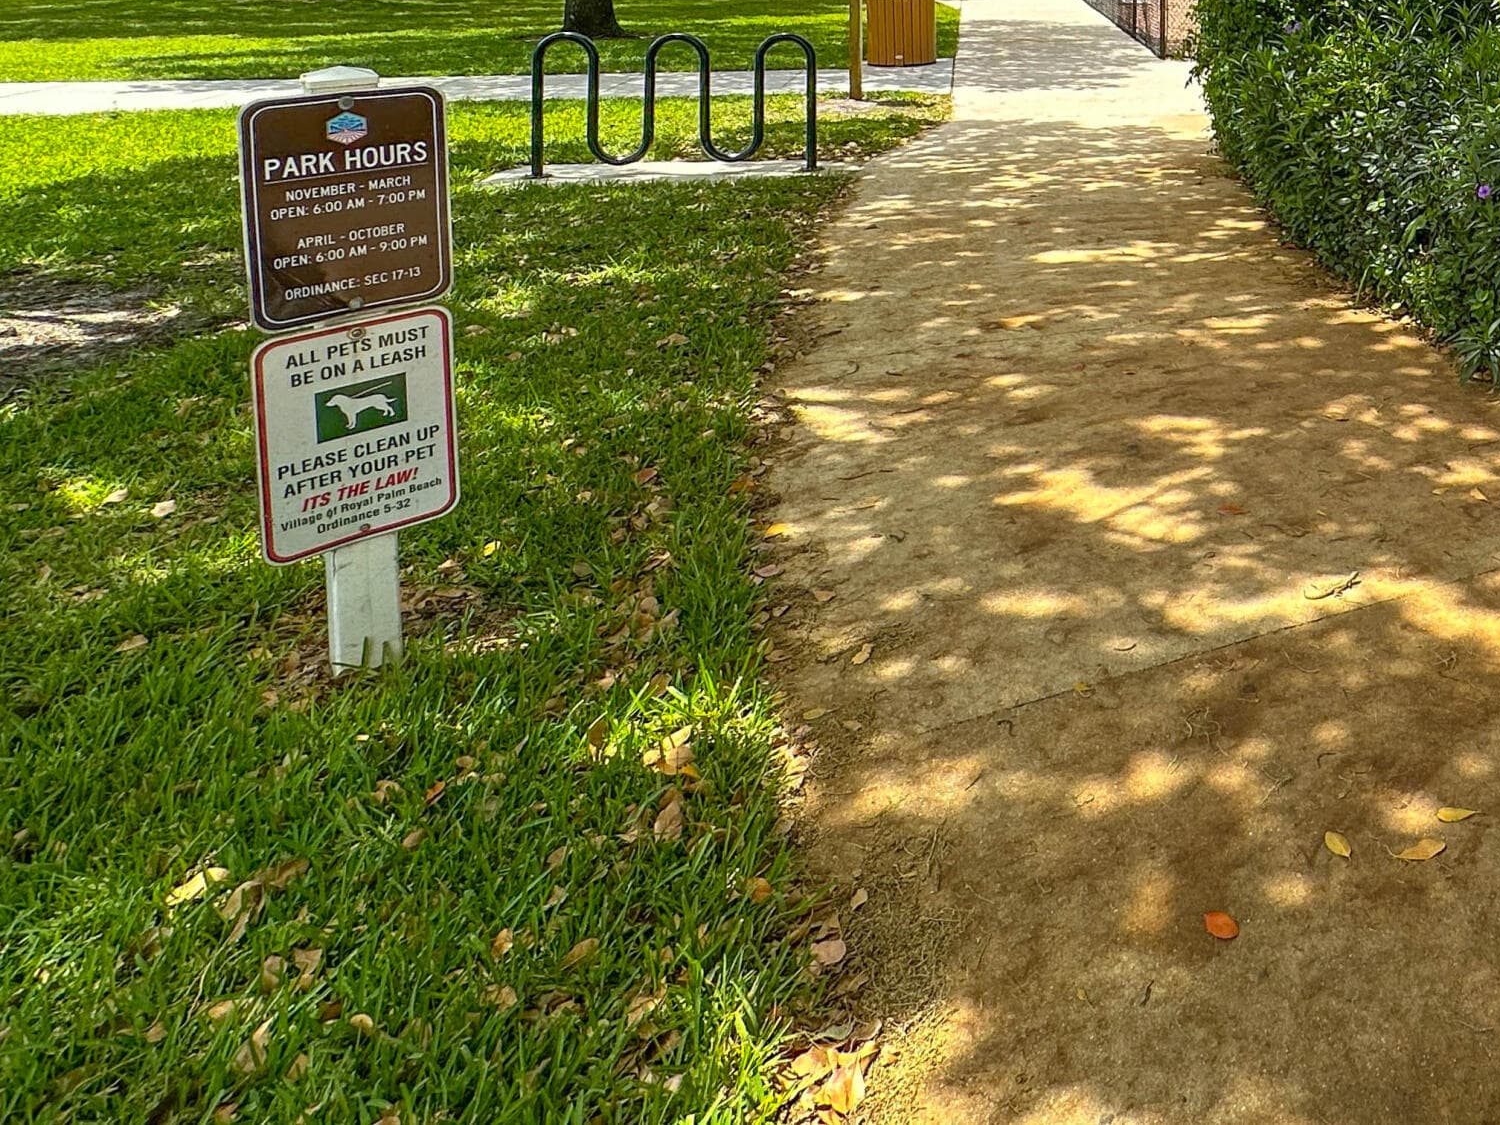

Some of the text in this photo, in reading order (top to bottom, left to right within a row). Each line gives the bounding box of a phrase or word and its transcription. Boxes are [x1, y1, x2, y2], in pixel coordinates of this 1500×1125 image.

[264, 141, 428, 181] PARK HOURS
[270, 206, 309, 220] OPEN:
[313, 200, 343, 215] 6:00
[347, 197, 365, 209] AM
[377, 192, 406, 206] 7:00
[409, 189, 426, 200] PM
[286, 182, 356, 202] NOVEMBER
[368, 175, 411, 190] MARCH
[273, 254, 312, 270] OPEN:
[315, 249, 345, 263] 6:00
[349, 244, 367, 258] AM
[379, 239, 408, 252] 9:00
[411, 235, 427, 248] PM
[297, 234, 336, 249] APRIL
[349, 223, 405, 242] OCTOBER
[285, 266, 421, 300] ORDINANCE: SEC 17-13
[286, 326, 429, 369] ALL PETS MUST
[291, 346, 426, 387] BE ON A LEASH
[278, 425, 439, 480] PLEASE CLEAN UP
[284, 444, 437, 498] AFTER YOUR PET
[281, 477, 442, 532] Village of Royal Palm Beach
[302, 467, 418, 512] ITS THE LAW!
[317, 498, 411, 534] Ordinance 5-32
